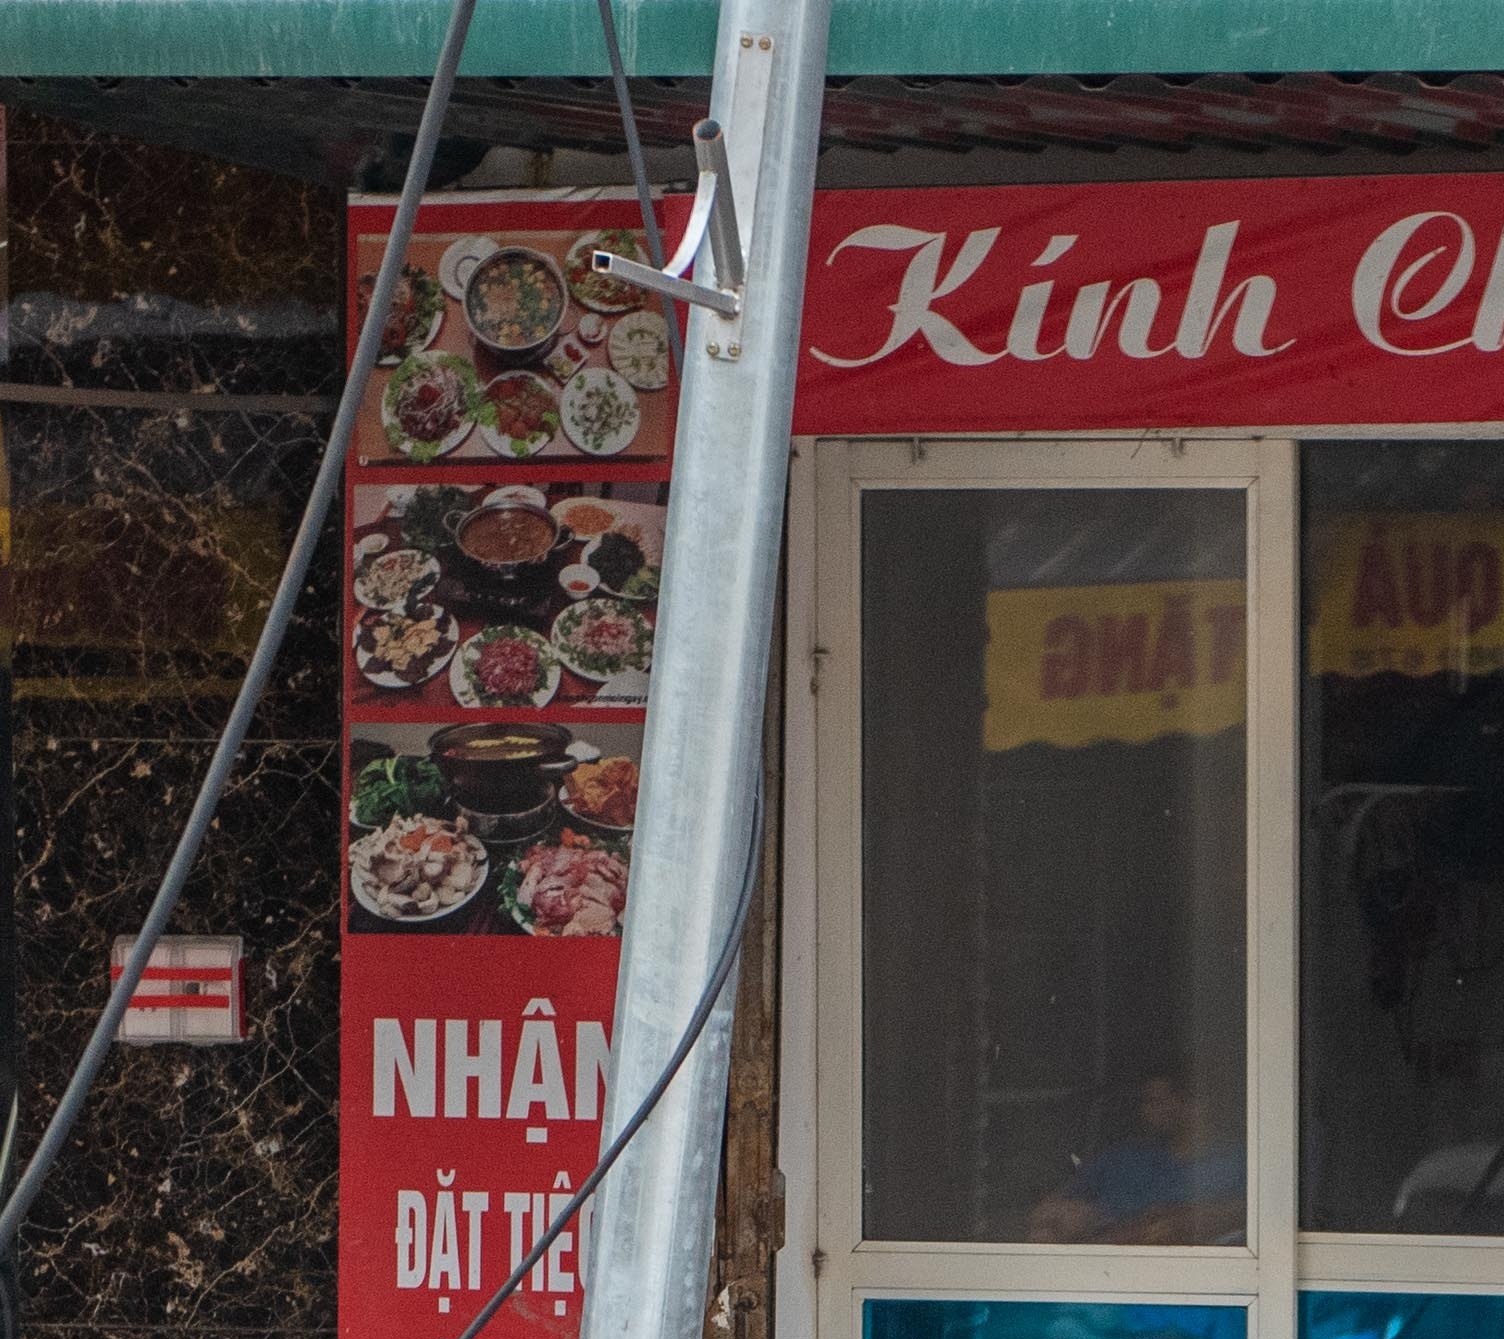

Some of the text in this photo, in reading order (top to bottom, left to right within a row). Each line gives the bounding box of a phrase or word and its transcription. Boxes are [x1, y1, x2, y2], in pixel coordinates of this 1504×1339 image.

[809, 219, 1296, 367] Kính
[372, 997, 612, 1144] NHẬN
[394, 1167, 489, 1314] ĐẶT
